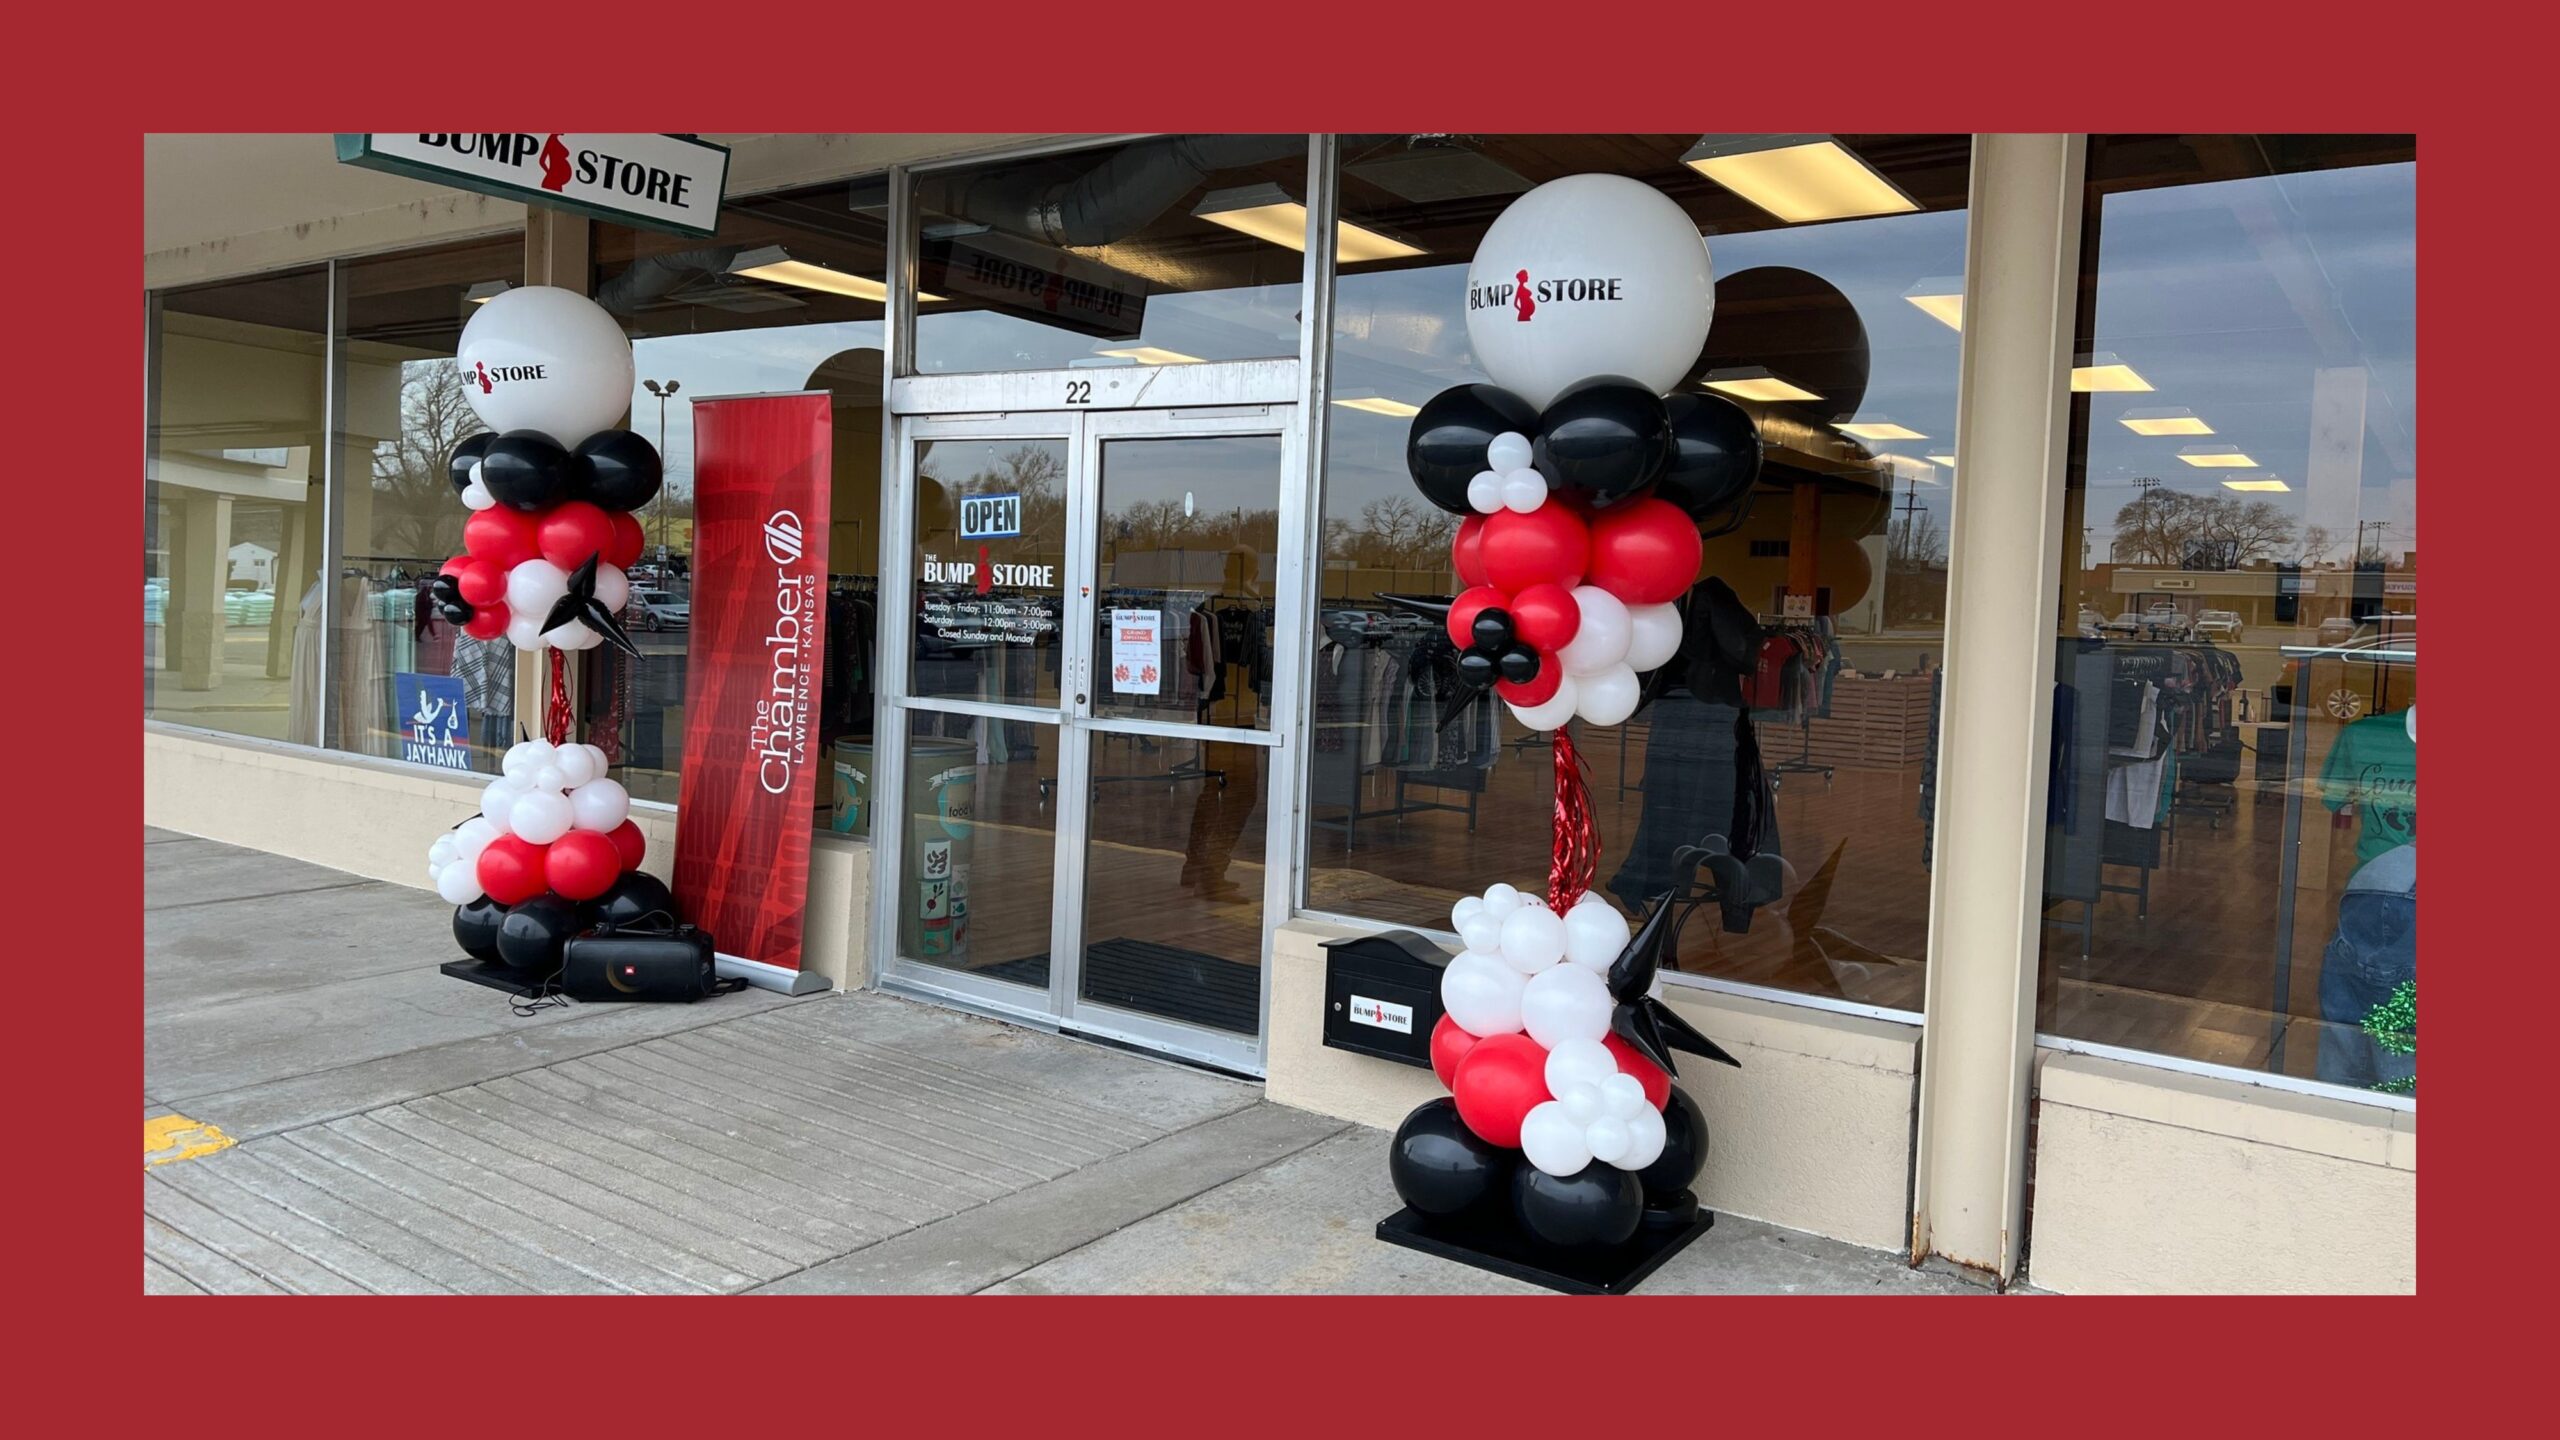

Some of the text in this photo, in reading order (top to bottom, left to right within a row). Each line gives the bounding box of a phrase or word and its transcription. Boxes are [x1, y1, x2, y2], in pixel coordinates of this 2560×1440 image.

[575, 150, 693, 209] STORE
[1470, 278, 1623, 311] BUMP STORE
[490, 364, 548, 383] STORE
[1066, 380, 1091, 404] 22
[964, 498, 1017, 535] OPEN
[925, 553, 937, 562] THE
[923, 561, 1055, 588] BUMP STORE
[924, 601, 951, 613] Tuesday
[957, 604, 980, 615] Friday:
[984, 604, 1017, 616] 11:00am
[1023, 605, 1053, 618] 7:00pm
[923, 615, 955, 626] Saturday:
[984, 617, 1016, 630] 12:00pm
[1022, 620, 1053, 632] 5:00pm
[937, 627, 1035, 646] Closed Sunday and Monday
[760, 567, 802, 795] Chamber
[793, 662, 811, 764] LAWRENCE
[802, 574, 816, 649] KANSAS
[413, 724, 455, 748] IT'S A
[751, 699, 770, 750] The
[406, 743, 468, 770] JAYHAWK
[1353, 1006, 1408, 1025] BUMP STORE
